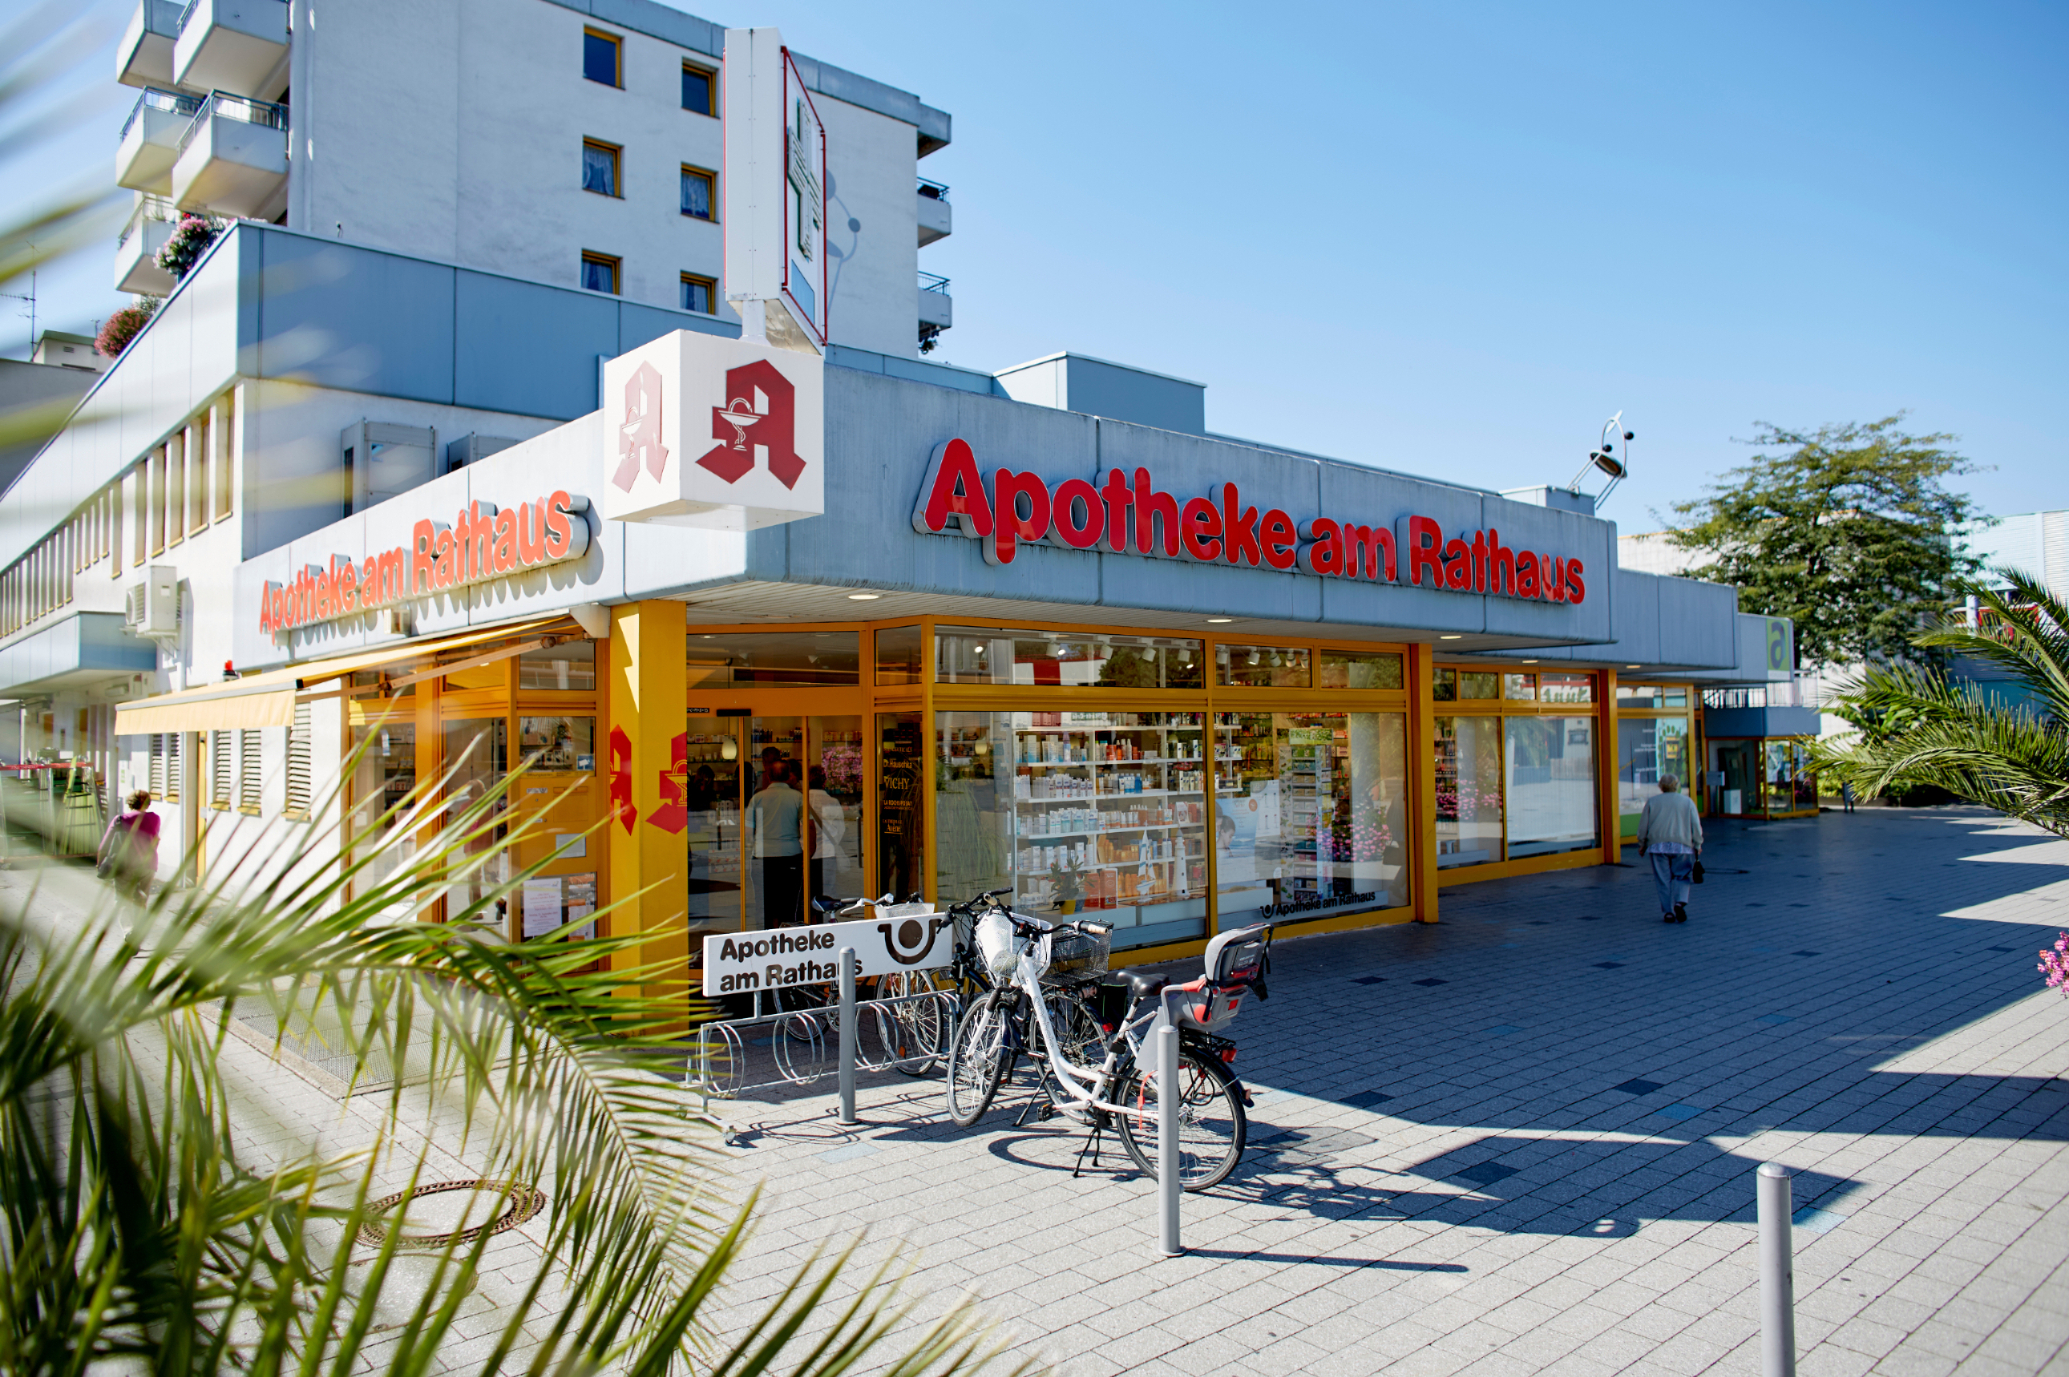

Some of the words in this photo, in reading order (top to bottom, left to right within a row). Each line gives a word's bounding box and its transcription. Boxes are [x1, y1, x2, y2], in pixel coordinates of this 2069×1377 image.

[917, 437, 1296, 569] Apotheke
[1308, 516, 1397, 581] am
[1407, 514, 1585, 604] Rathaus
[259, 553, 356, 646] Apotheke
[361, 546, 404, 608] am
[411, 490, 572, 596] Rathaus
[884, 777, 910, 790] VICHY
[1276, 898, 1322, 917] Apotheke
[1322, 899, 1338, 909] am
[1339, 891, 1376, 906] Rathaus
[720, 929, 835, 963] Apotheke
[719, 972, 760, 992] am
[765, 959, 864, 987] Rathas
